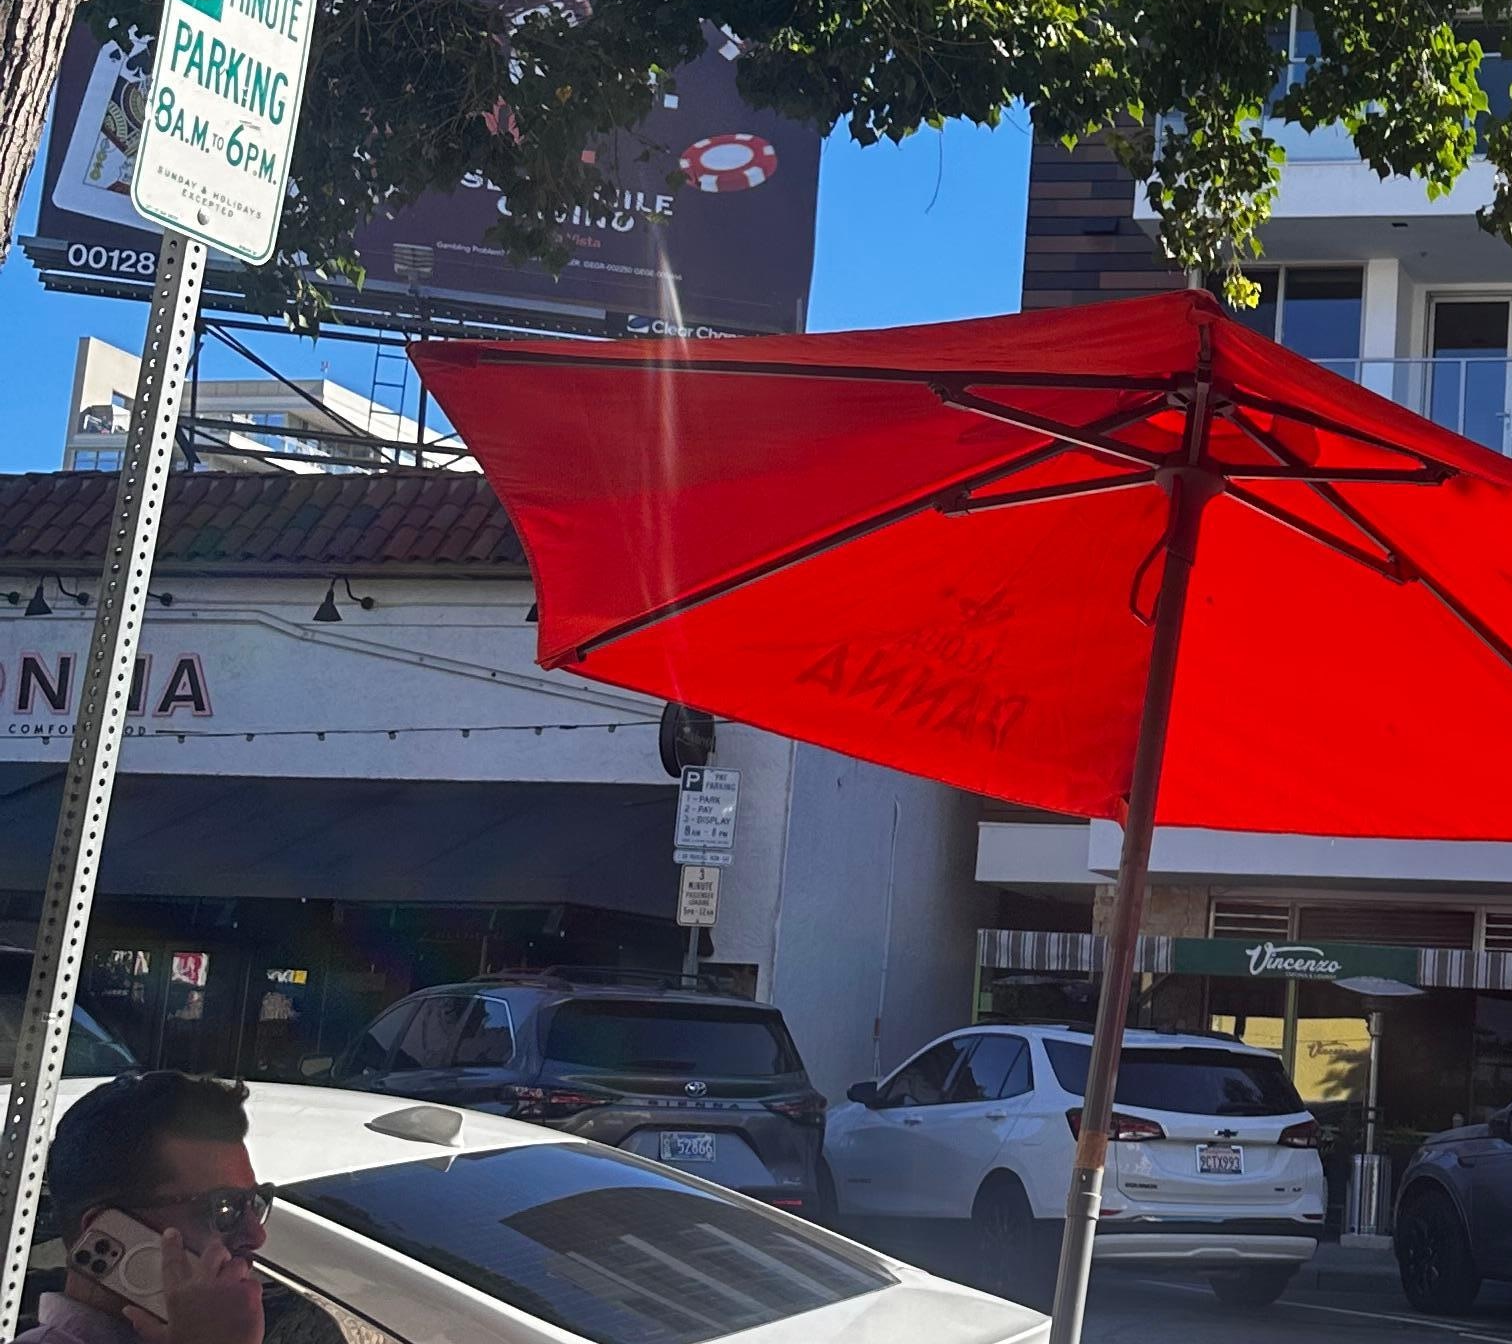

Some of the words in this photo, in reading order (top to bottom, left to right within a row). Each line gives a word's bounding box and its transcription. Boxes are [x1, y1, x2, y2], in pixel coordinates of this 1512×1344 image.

[170, 18, 289, 126] PARKING
[211, 132, 225, 151] TO
[156, 164, 198, 189] SUNDAY
[212, 190, 263, 220] HOLIDAYS
[181, 188, 235, 219] EXCEPTED
[651, 319, 694, 338] Clear
[686, 771, 701, 788] P
[1245, 941, 1343, 976] Vincenzo
